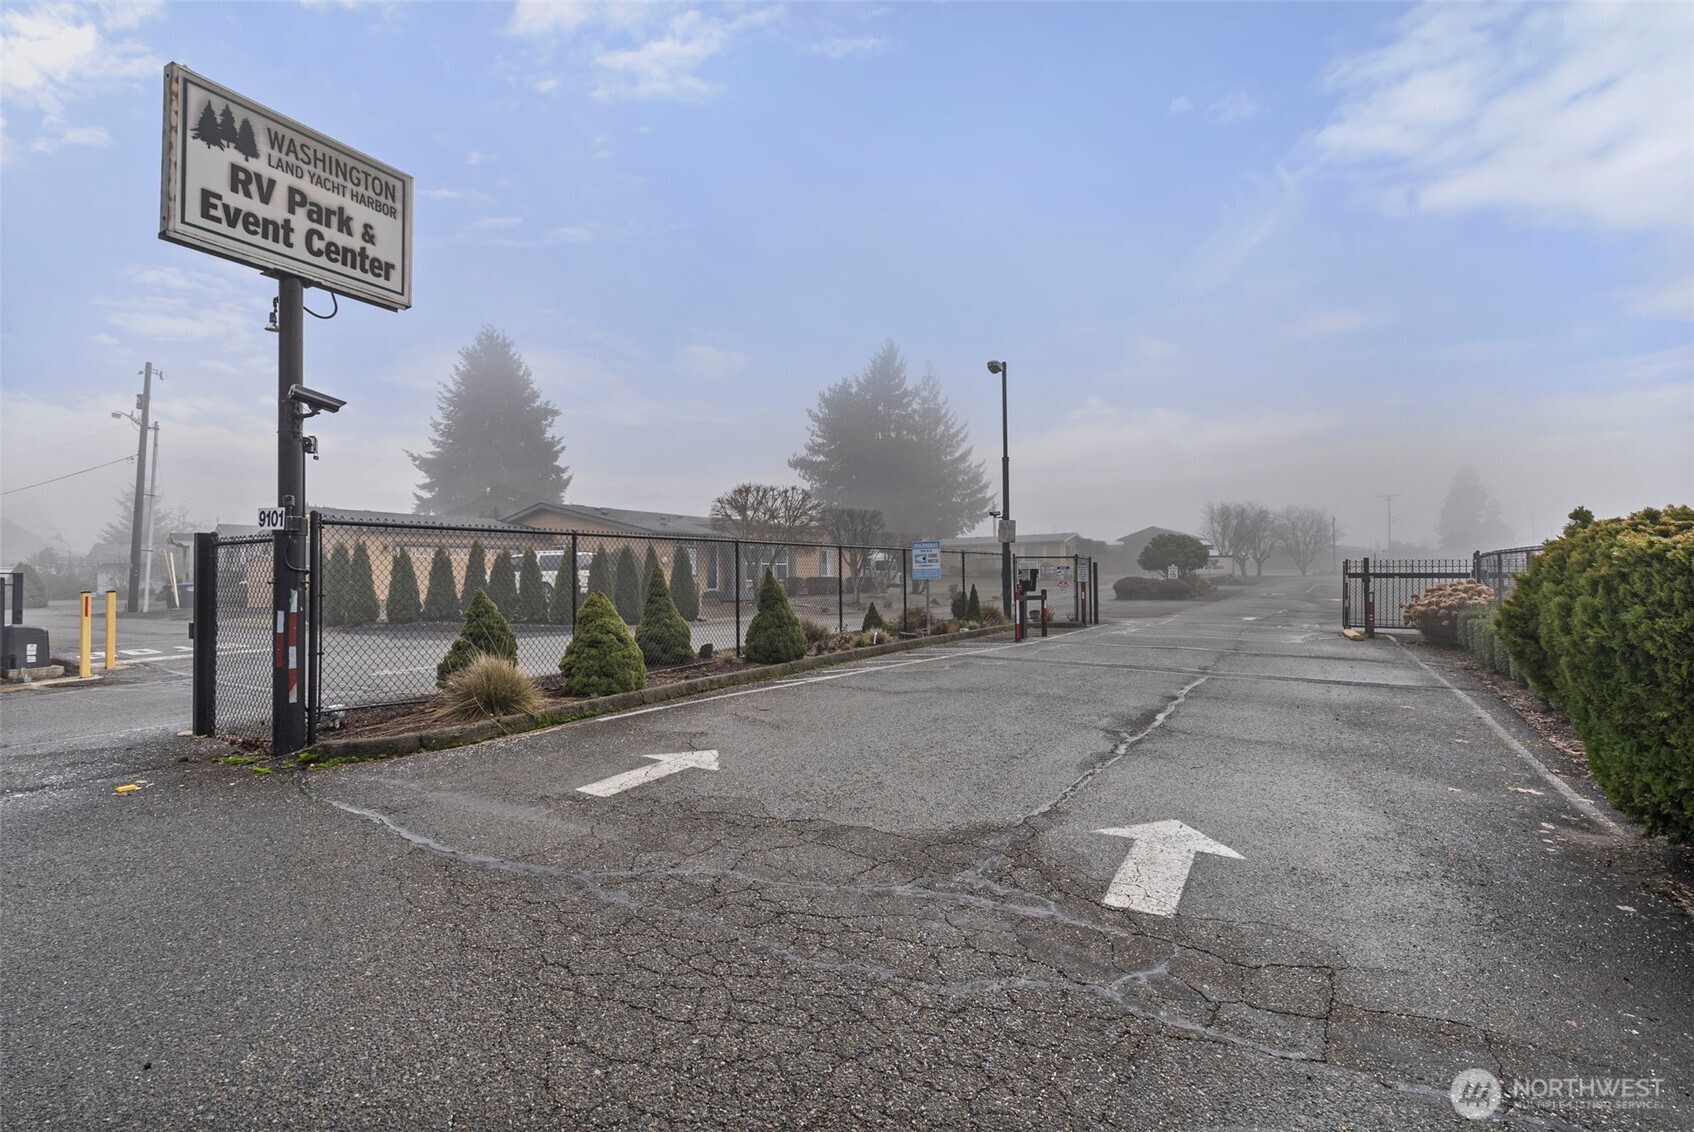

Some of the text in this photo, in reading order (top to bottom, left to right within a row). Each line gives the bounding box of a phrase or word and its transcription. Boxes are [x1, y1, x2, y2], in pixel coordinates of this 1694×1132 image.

[267, 127, 396, 203] WASHINGTON
[268, 153, 397, 220] LAND YACHT HARBOR
[200, 188, 395, 282] Event Center
[229, 163, 376, 246] RV Park &
[259, 510, 284, 527] 9101
